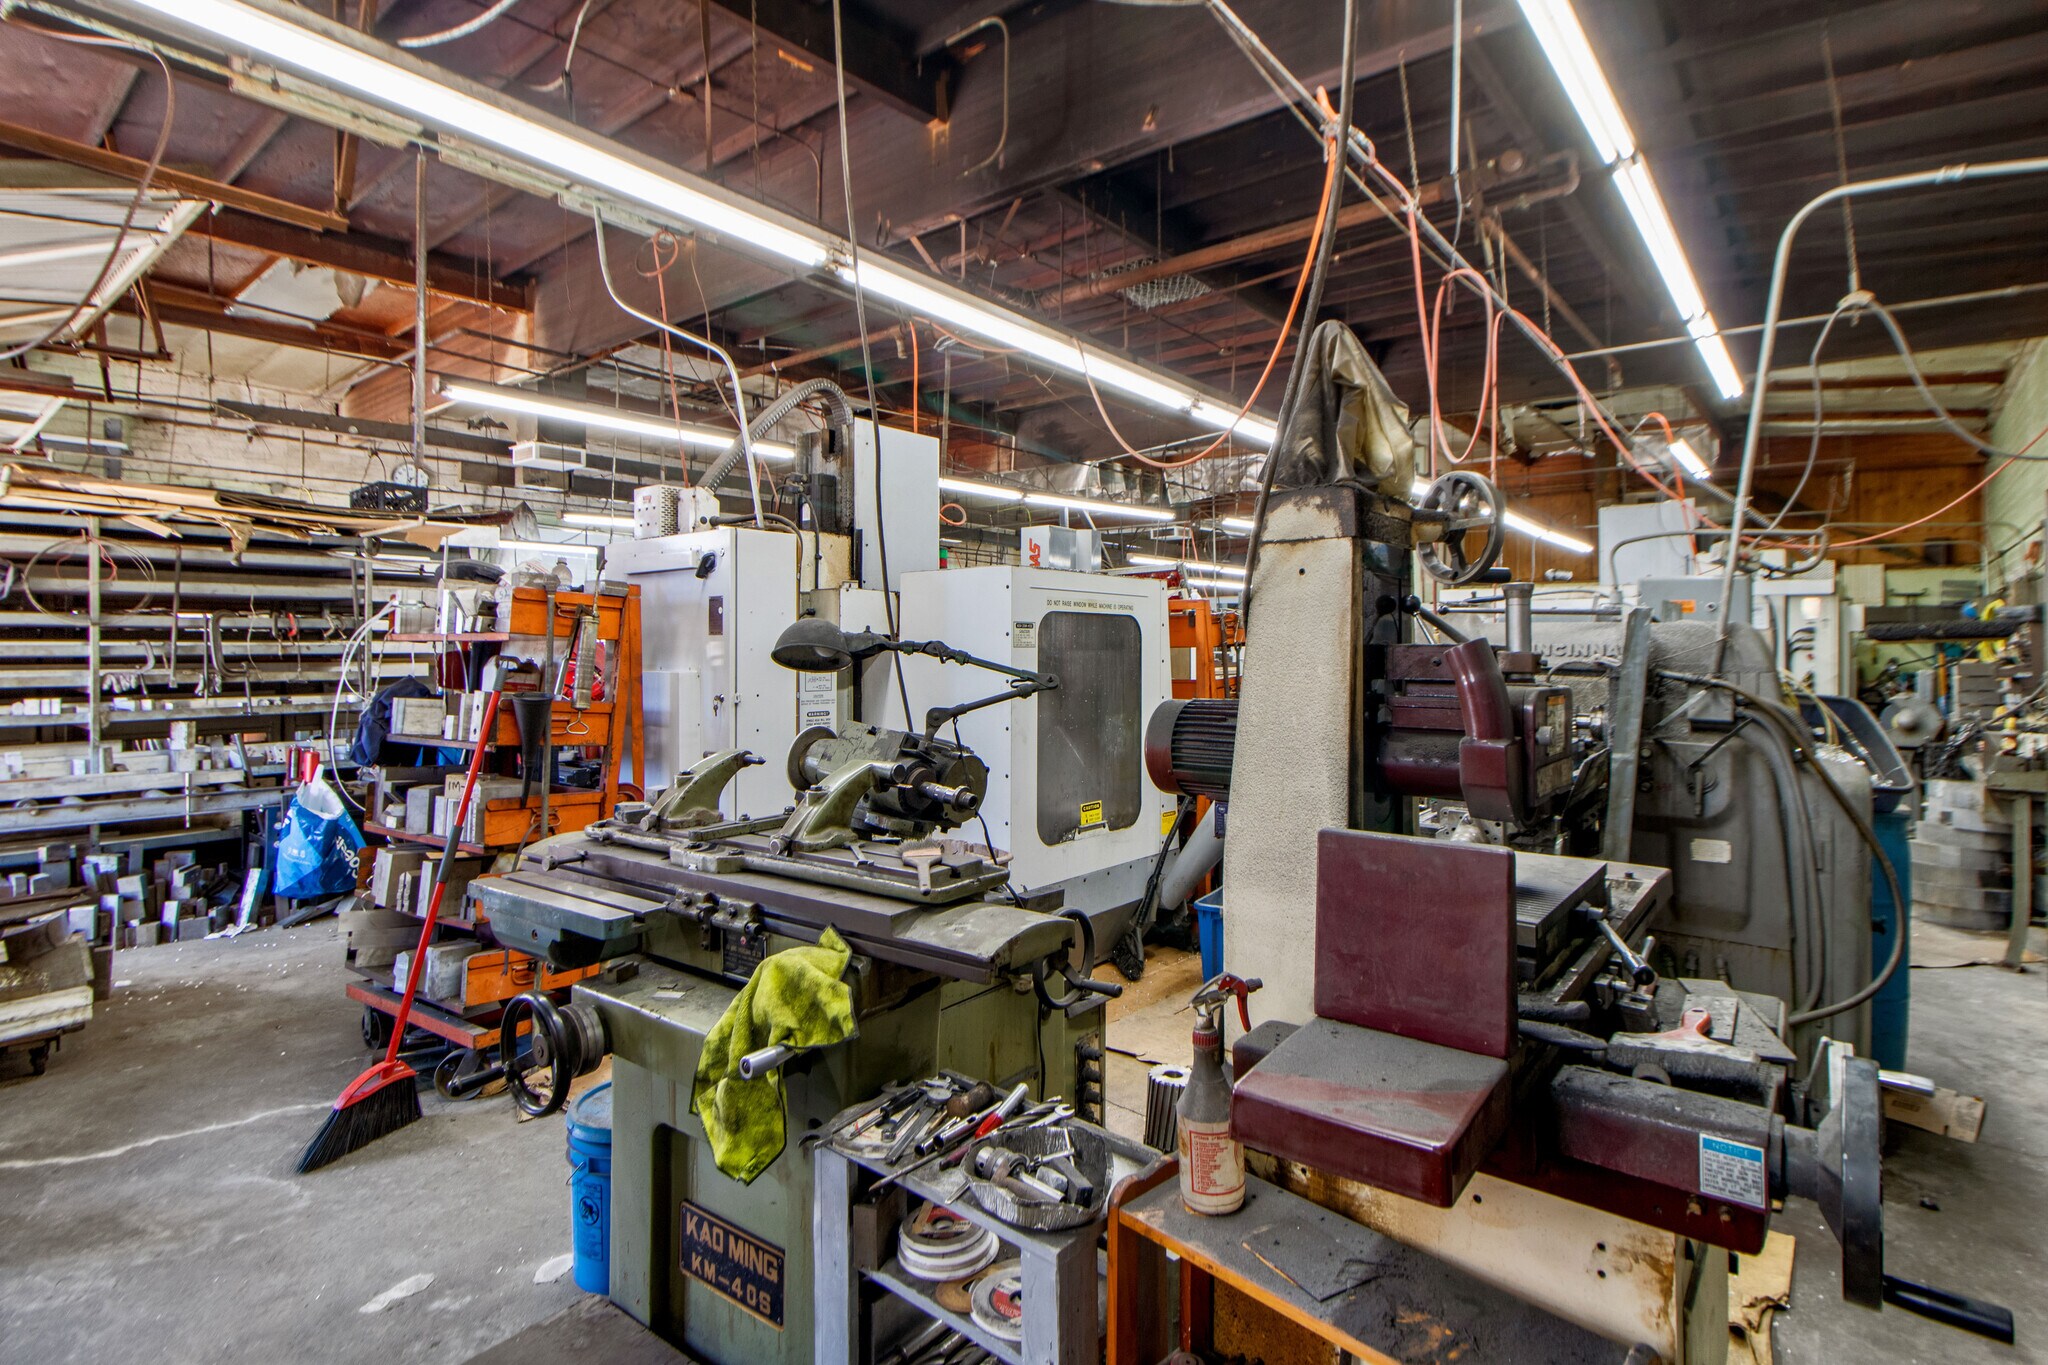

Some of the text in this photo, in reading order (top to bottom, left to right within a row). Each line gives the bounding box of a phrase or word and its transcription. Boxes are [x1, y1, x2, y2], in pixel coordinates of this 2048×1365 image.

[1712, 1142, 1751, 1157] NOTICE
[686, 1212, 778, 1284] KAO MING
[691, 1252, 771, 1316] KM-40S
